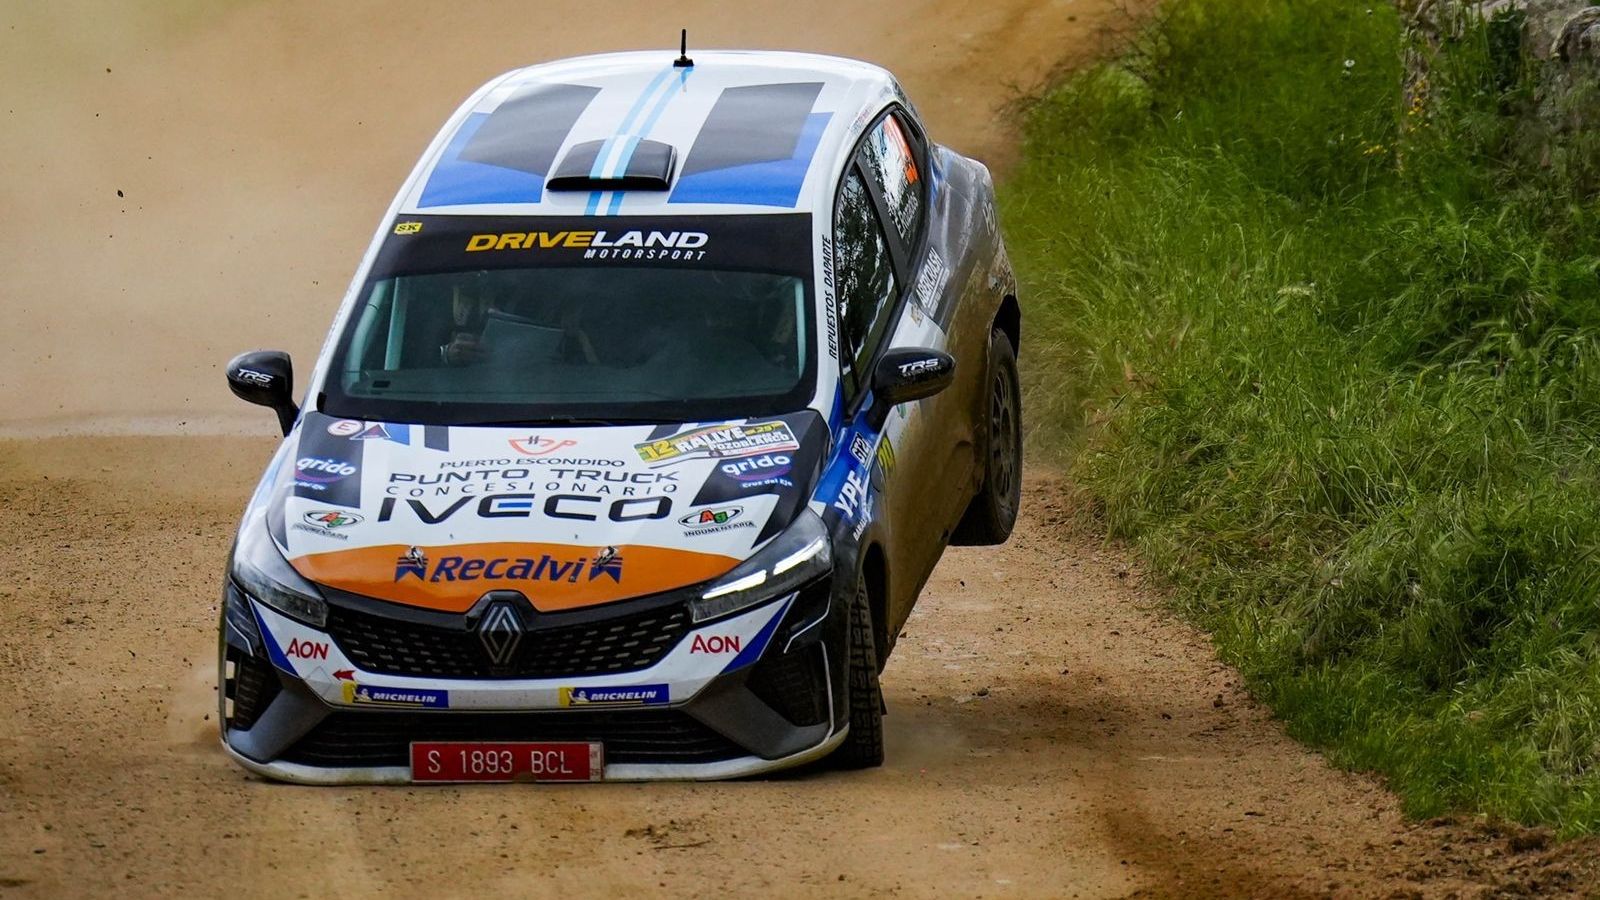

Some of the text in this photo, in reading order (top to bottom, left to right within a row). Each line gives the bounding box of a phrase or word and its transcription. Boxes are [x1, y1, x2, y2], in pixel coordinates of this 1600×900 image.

[465, 231, 709, 251] DRIVELAND
[583, 248, 707, 260] MOTORSPORT
[821, 234, 838, 360] REPUESTOS DAPARTE
[898, 358, 939, 373] TRS
[238, 368, 275, 383] TRS
[641, 440, 675, 459] 12
[675, 425, 747, 453] RALLYE
[296, 458, 357, 476] grido
[440, 458, 625, 469] PUERTO ESCONDIDO
[722, 455, 791, 474] grido
[389, 468, 680, 485] PUNTO TRUCK
[386, 482, 678, 498] CONCESIONARIO
[834, 470, 866, 518] YPF
[377, 493, 673, 525] IVECO
[430, 555, 587, 583] Recalvi
[286, 637, 329, 660] AON
[690, 634, 741, 654] AON
[373, 692, 437, 703] MICHELIN
[591, 691, 657, 701] MICHELIN
[427, 750, 441, 773] S
[459, 750, 513, 774] 1893
[531, 750, 573, 774] BCL
